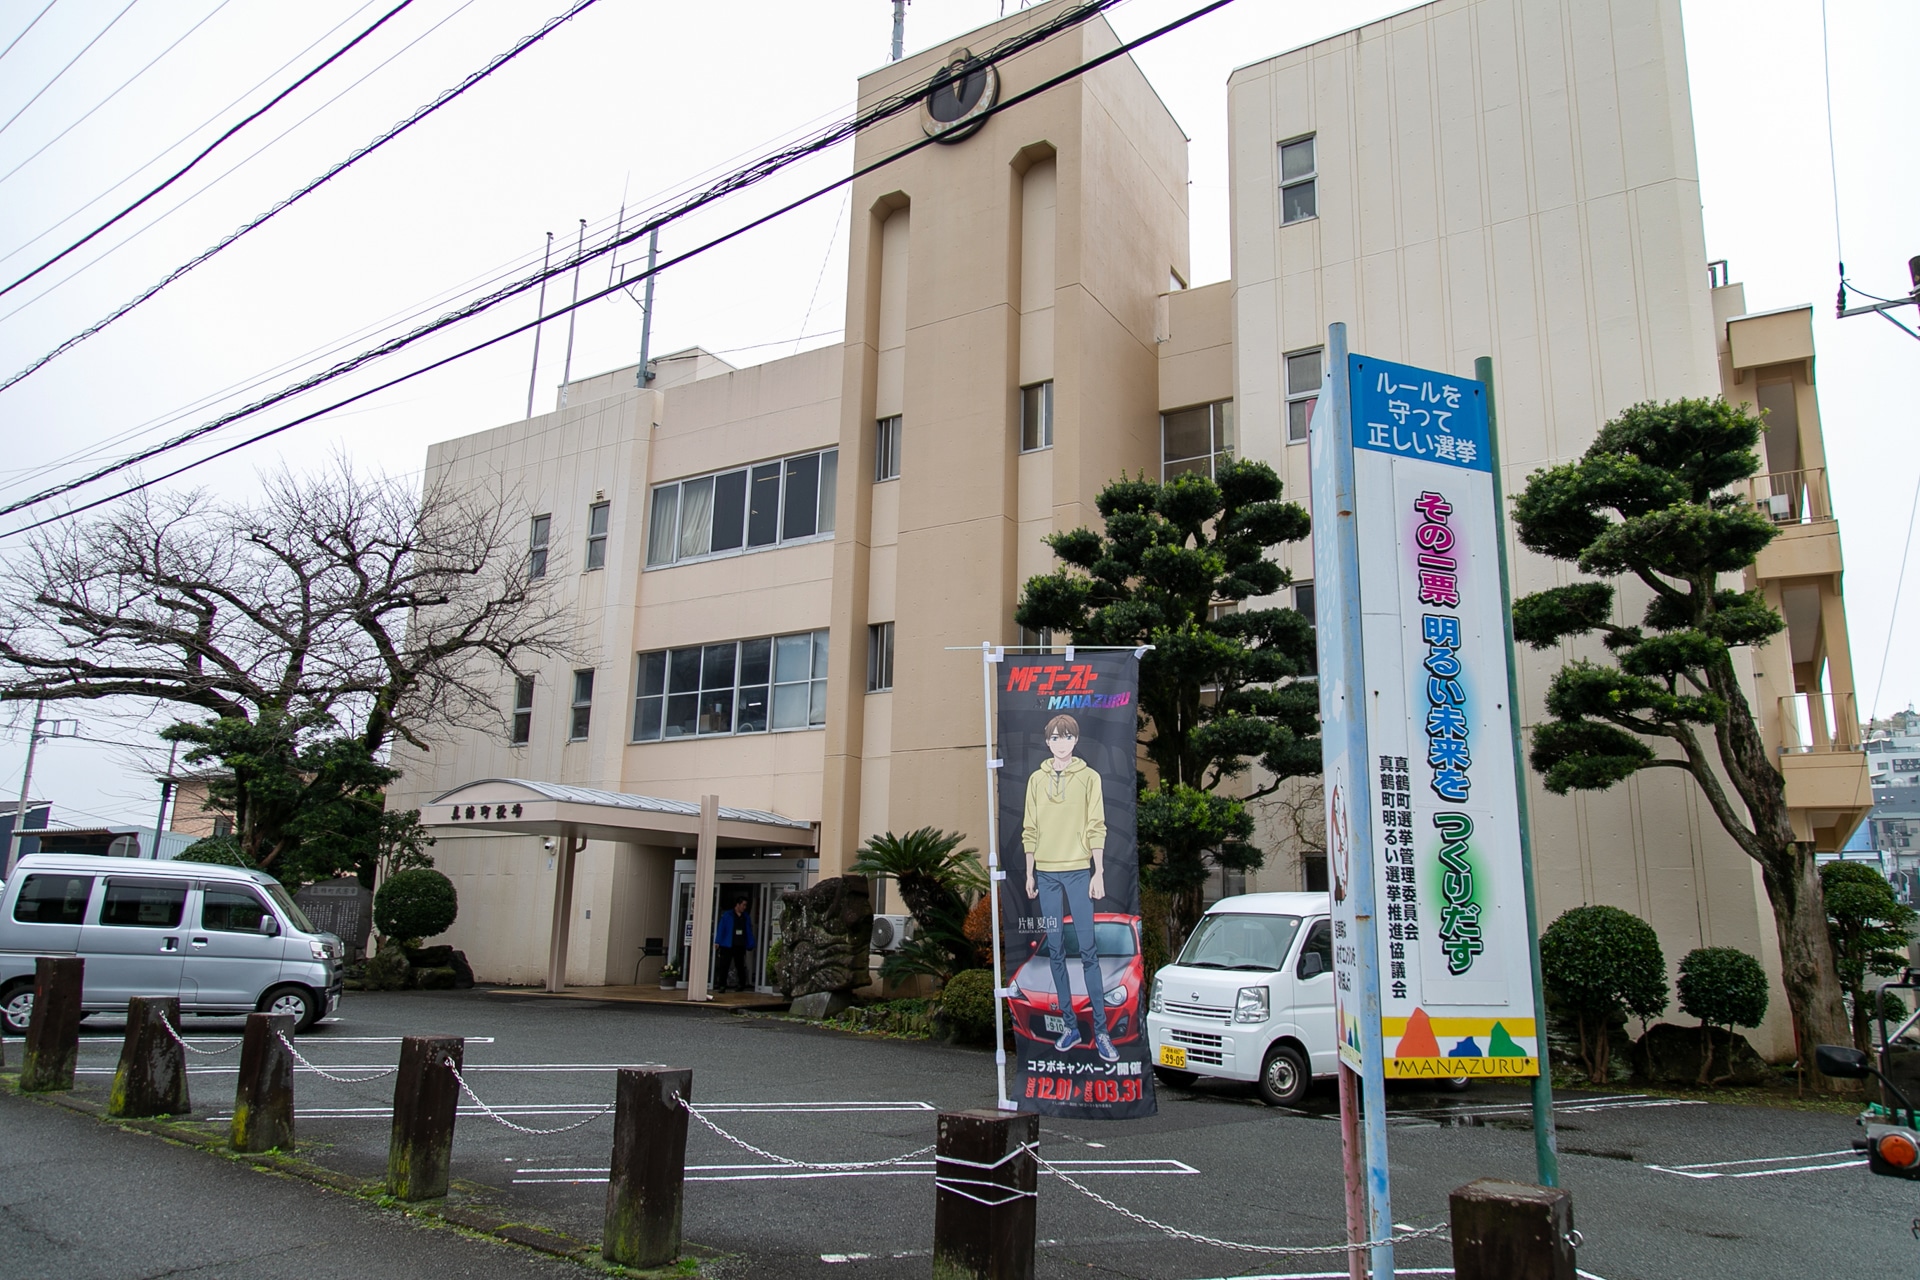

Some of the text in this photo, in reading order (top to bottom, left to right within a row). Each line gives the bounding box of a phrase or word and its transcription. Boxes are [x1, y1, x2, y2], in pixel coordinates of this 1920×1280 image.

[1376, 372, 1461, 409] ルールを
[1388, 399, 1452, 433] 守って
[1367, 421, 1477, 464] 正しい選挙
[1048, 692, 1131, 710] MANAZURU
[1415, 491, 1483, 976] その一票 明るい未来を つくりだす
[1394, 756, 1419, 941] 真鶴町選挙管理委員会
[1379, 755, 1408, 1000] 真鶴町明るい選挙推進協議会
[1027, 1060, 1142, 1076] コラボキャンペーン開催
[1398, 1057, 1526, 1077] MANAZURU
[1037, 1076, 1073, 1101] 12.01
[1093, 1078, 1143, 1103] 03.31
